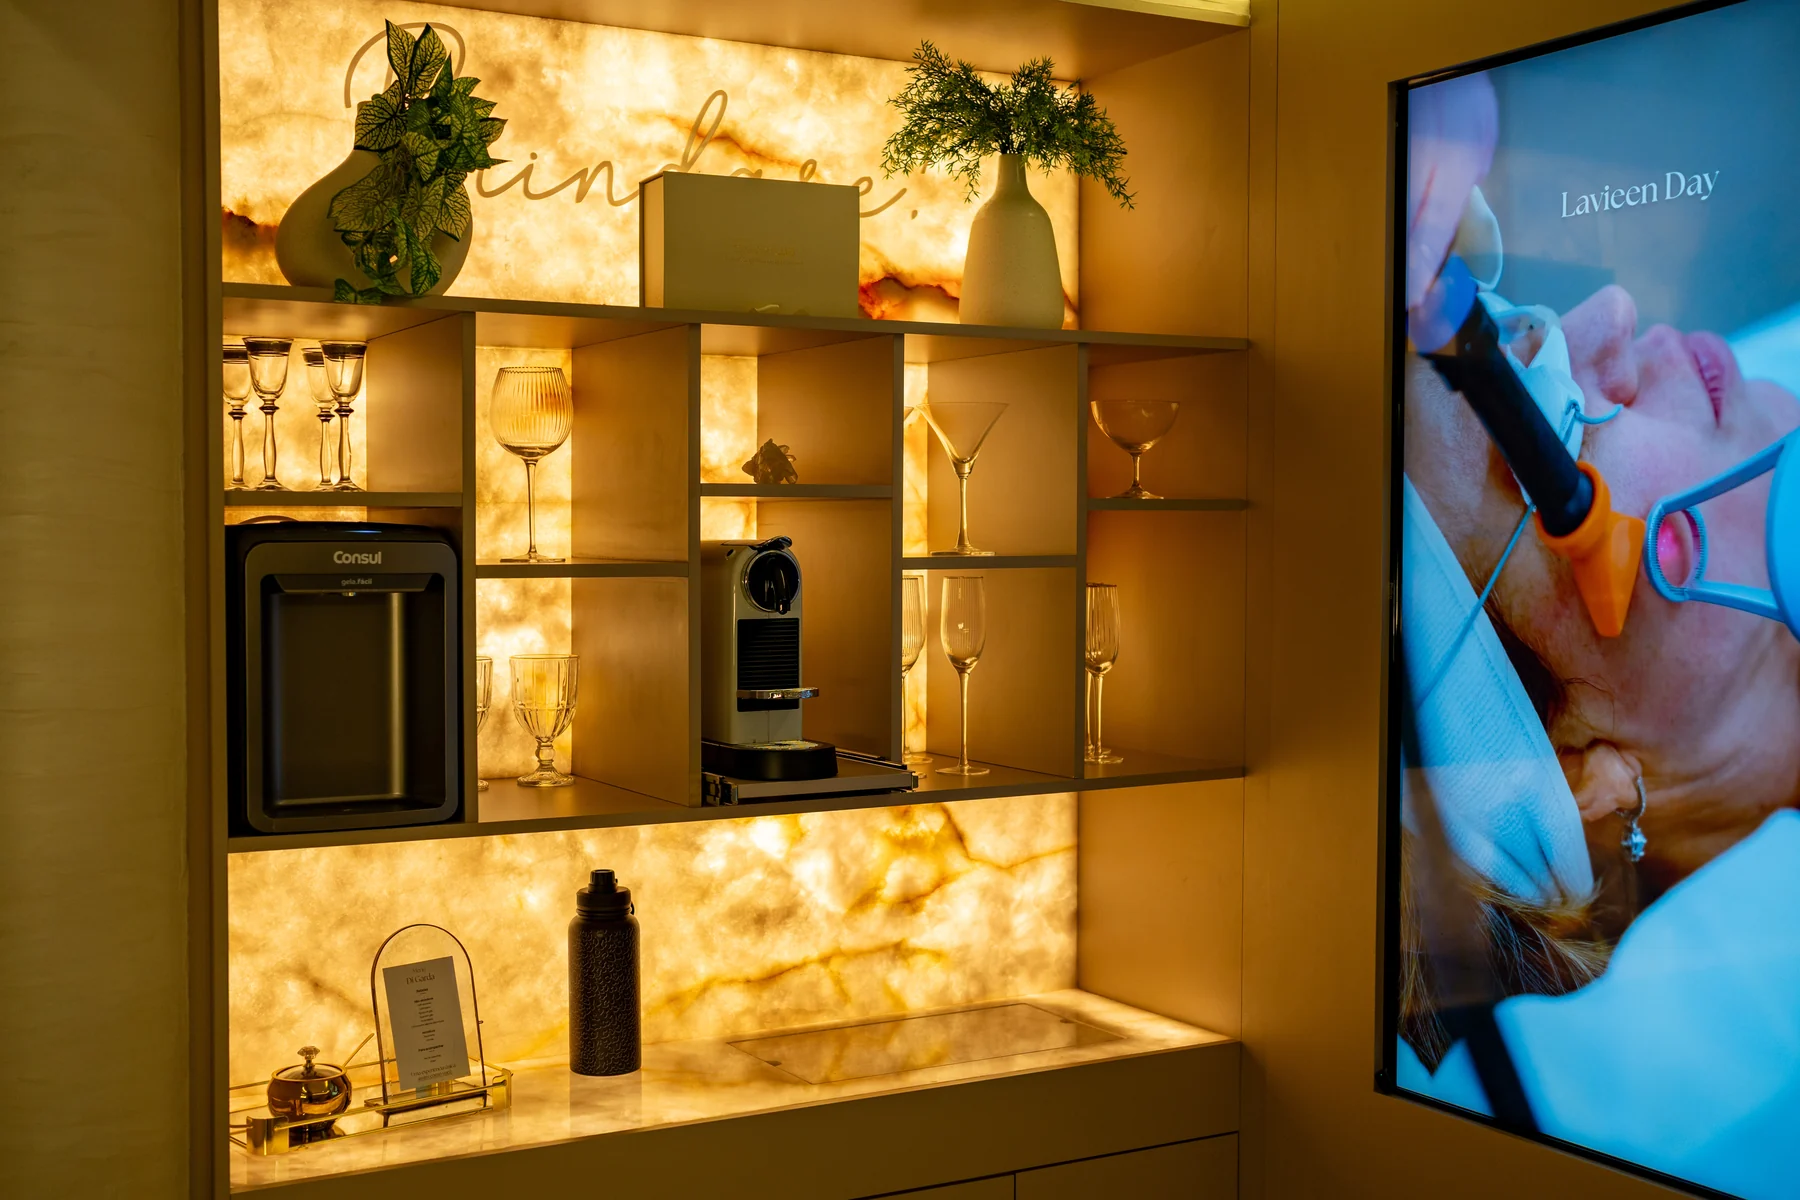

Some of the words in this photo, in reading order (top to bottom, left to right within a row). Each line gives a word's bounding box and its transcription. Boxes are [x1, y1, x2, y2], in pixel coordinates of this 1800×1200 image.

[1561, 182, 1658, 218] Lavieen
[1664, 170, 1720, 201] Day
[333, 550, 382, 565] Consul
